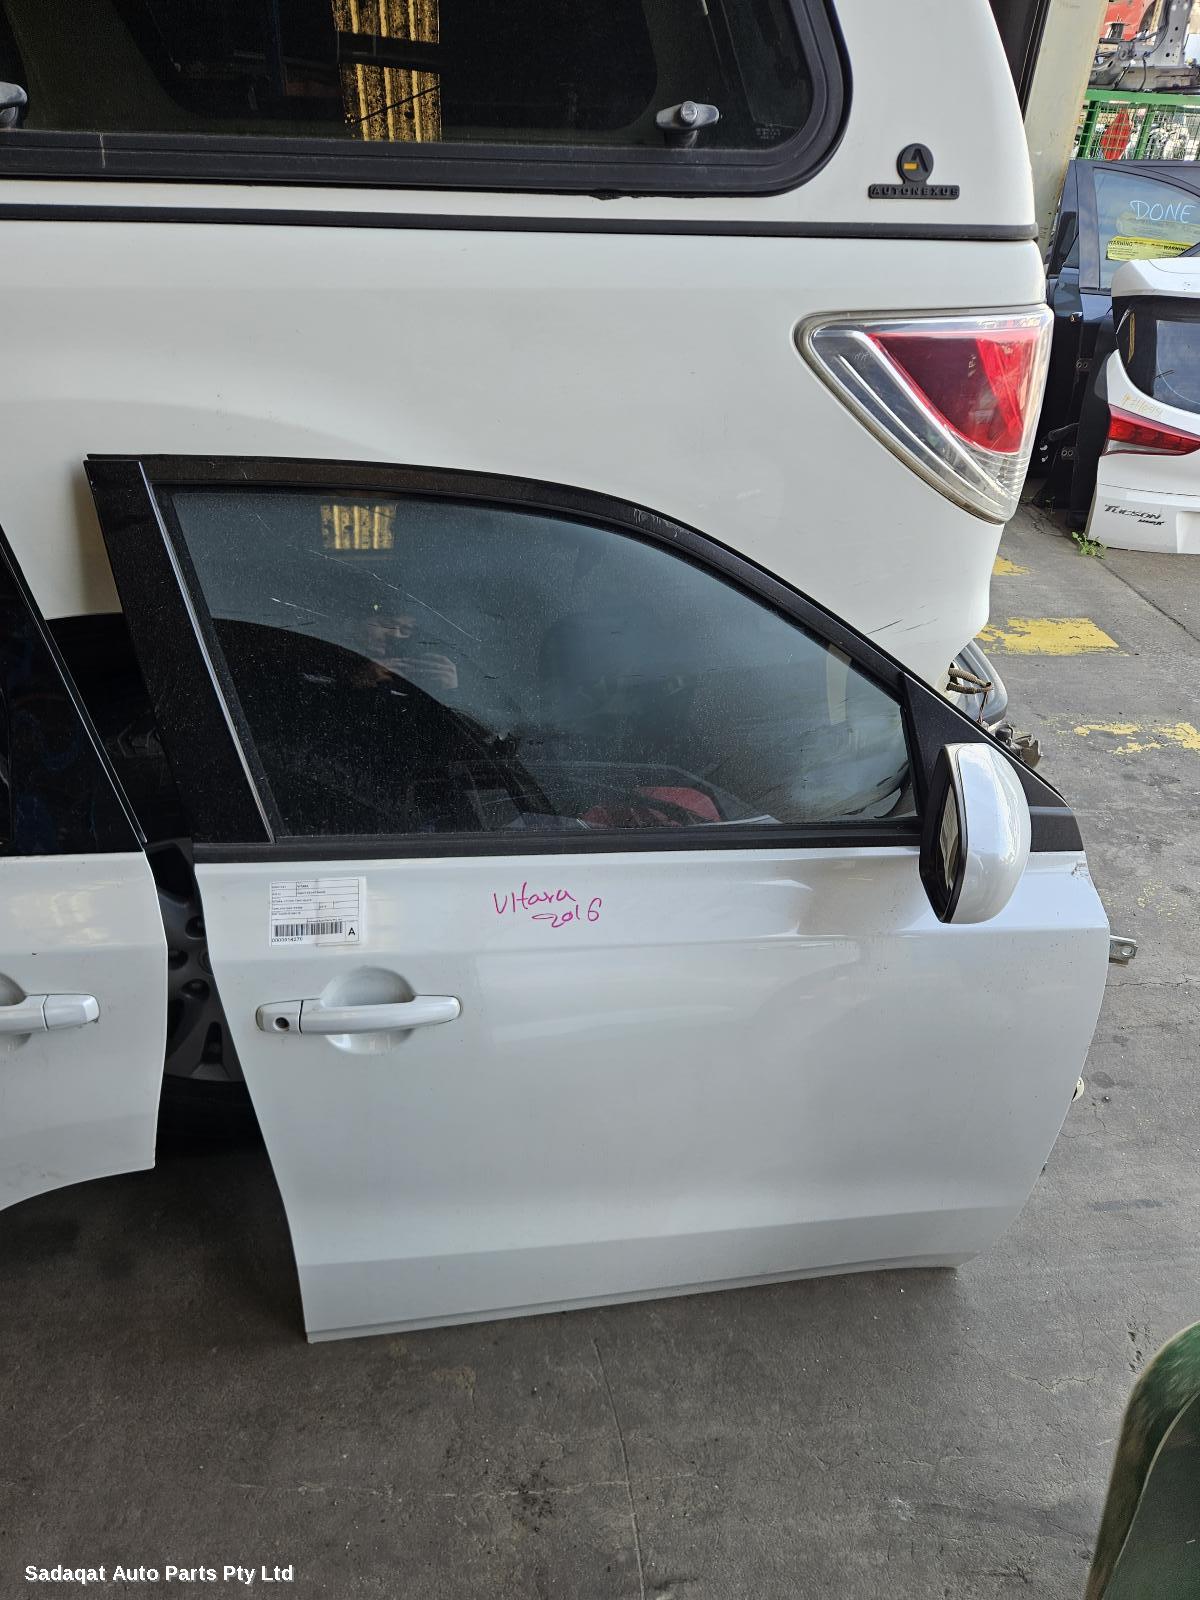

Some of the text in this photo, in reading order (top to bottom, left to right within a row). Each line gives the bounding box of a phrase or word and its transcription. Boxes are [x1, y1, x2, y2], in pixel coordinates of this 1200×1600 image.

[871, 185, 958, 196] AUTONEXUS
[1130, 200, 1196, 223] DONE
[531, 897, 602, 928] 2016
[348, 927, 356, 936] A
